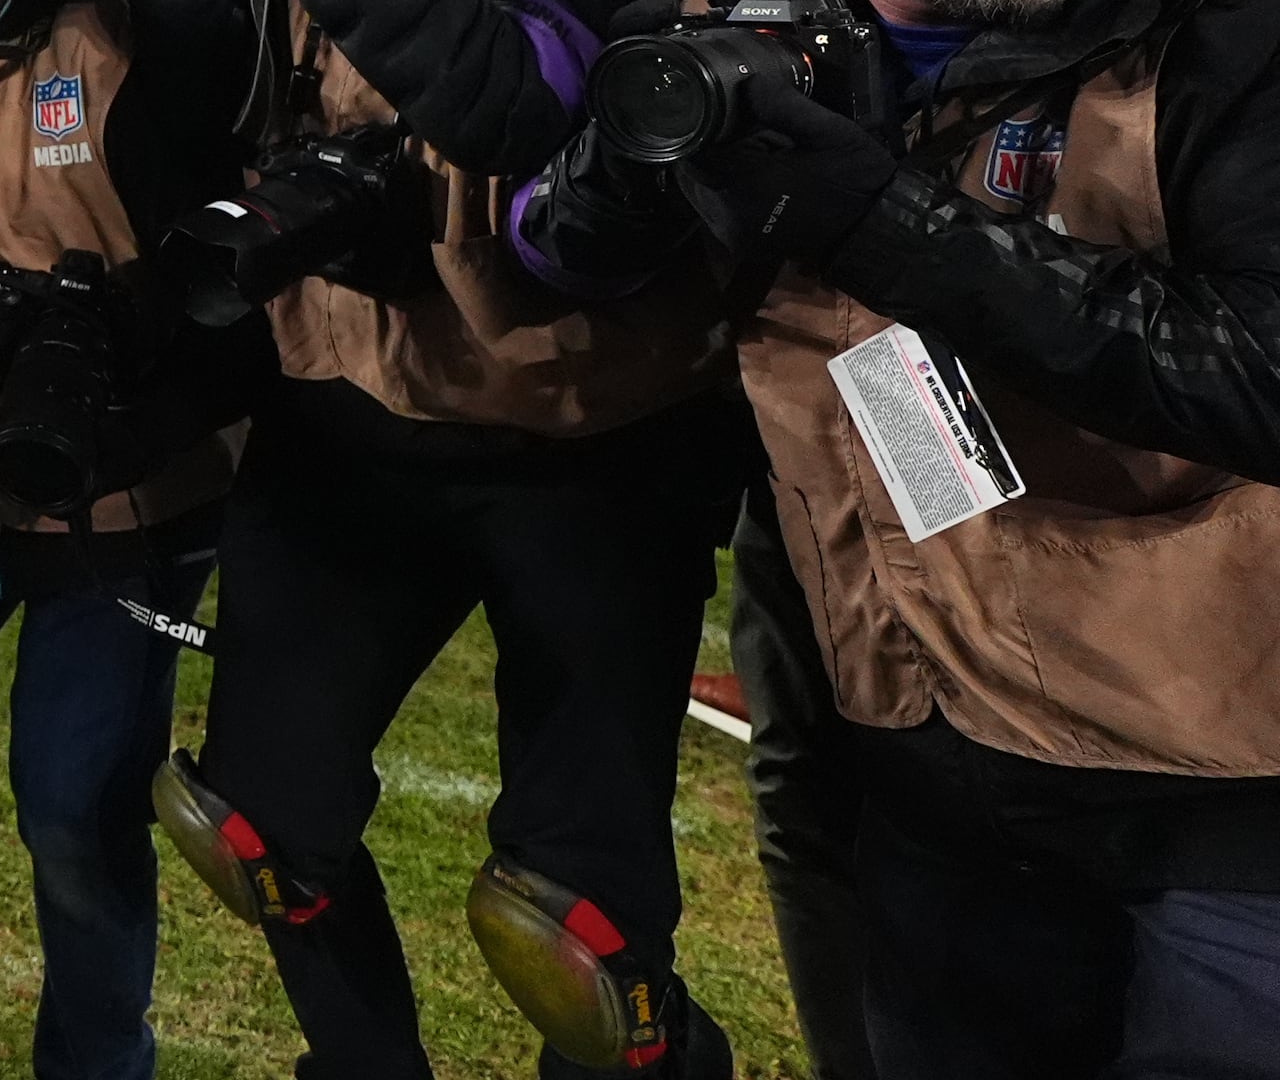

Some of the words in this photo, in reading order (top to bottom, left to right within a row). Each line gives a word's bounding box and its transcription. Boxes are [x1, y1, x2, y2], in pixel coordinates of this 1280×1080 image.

[741, 7, 782, 16] SONY
[738, 64, 749, 74] G
[40, 100, 77, 130] NFL
[33, 141, 93, 168] MEDIA
[762, 194, 791, 234] HEAD
[60, 278, 90, 291] Nikon
[932, 387, 956, 425] CREDENTIAL
[958, 436, 975, 459] TERMS
[153, 613, 207, 648] NPS
